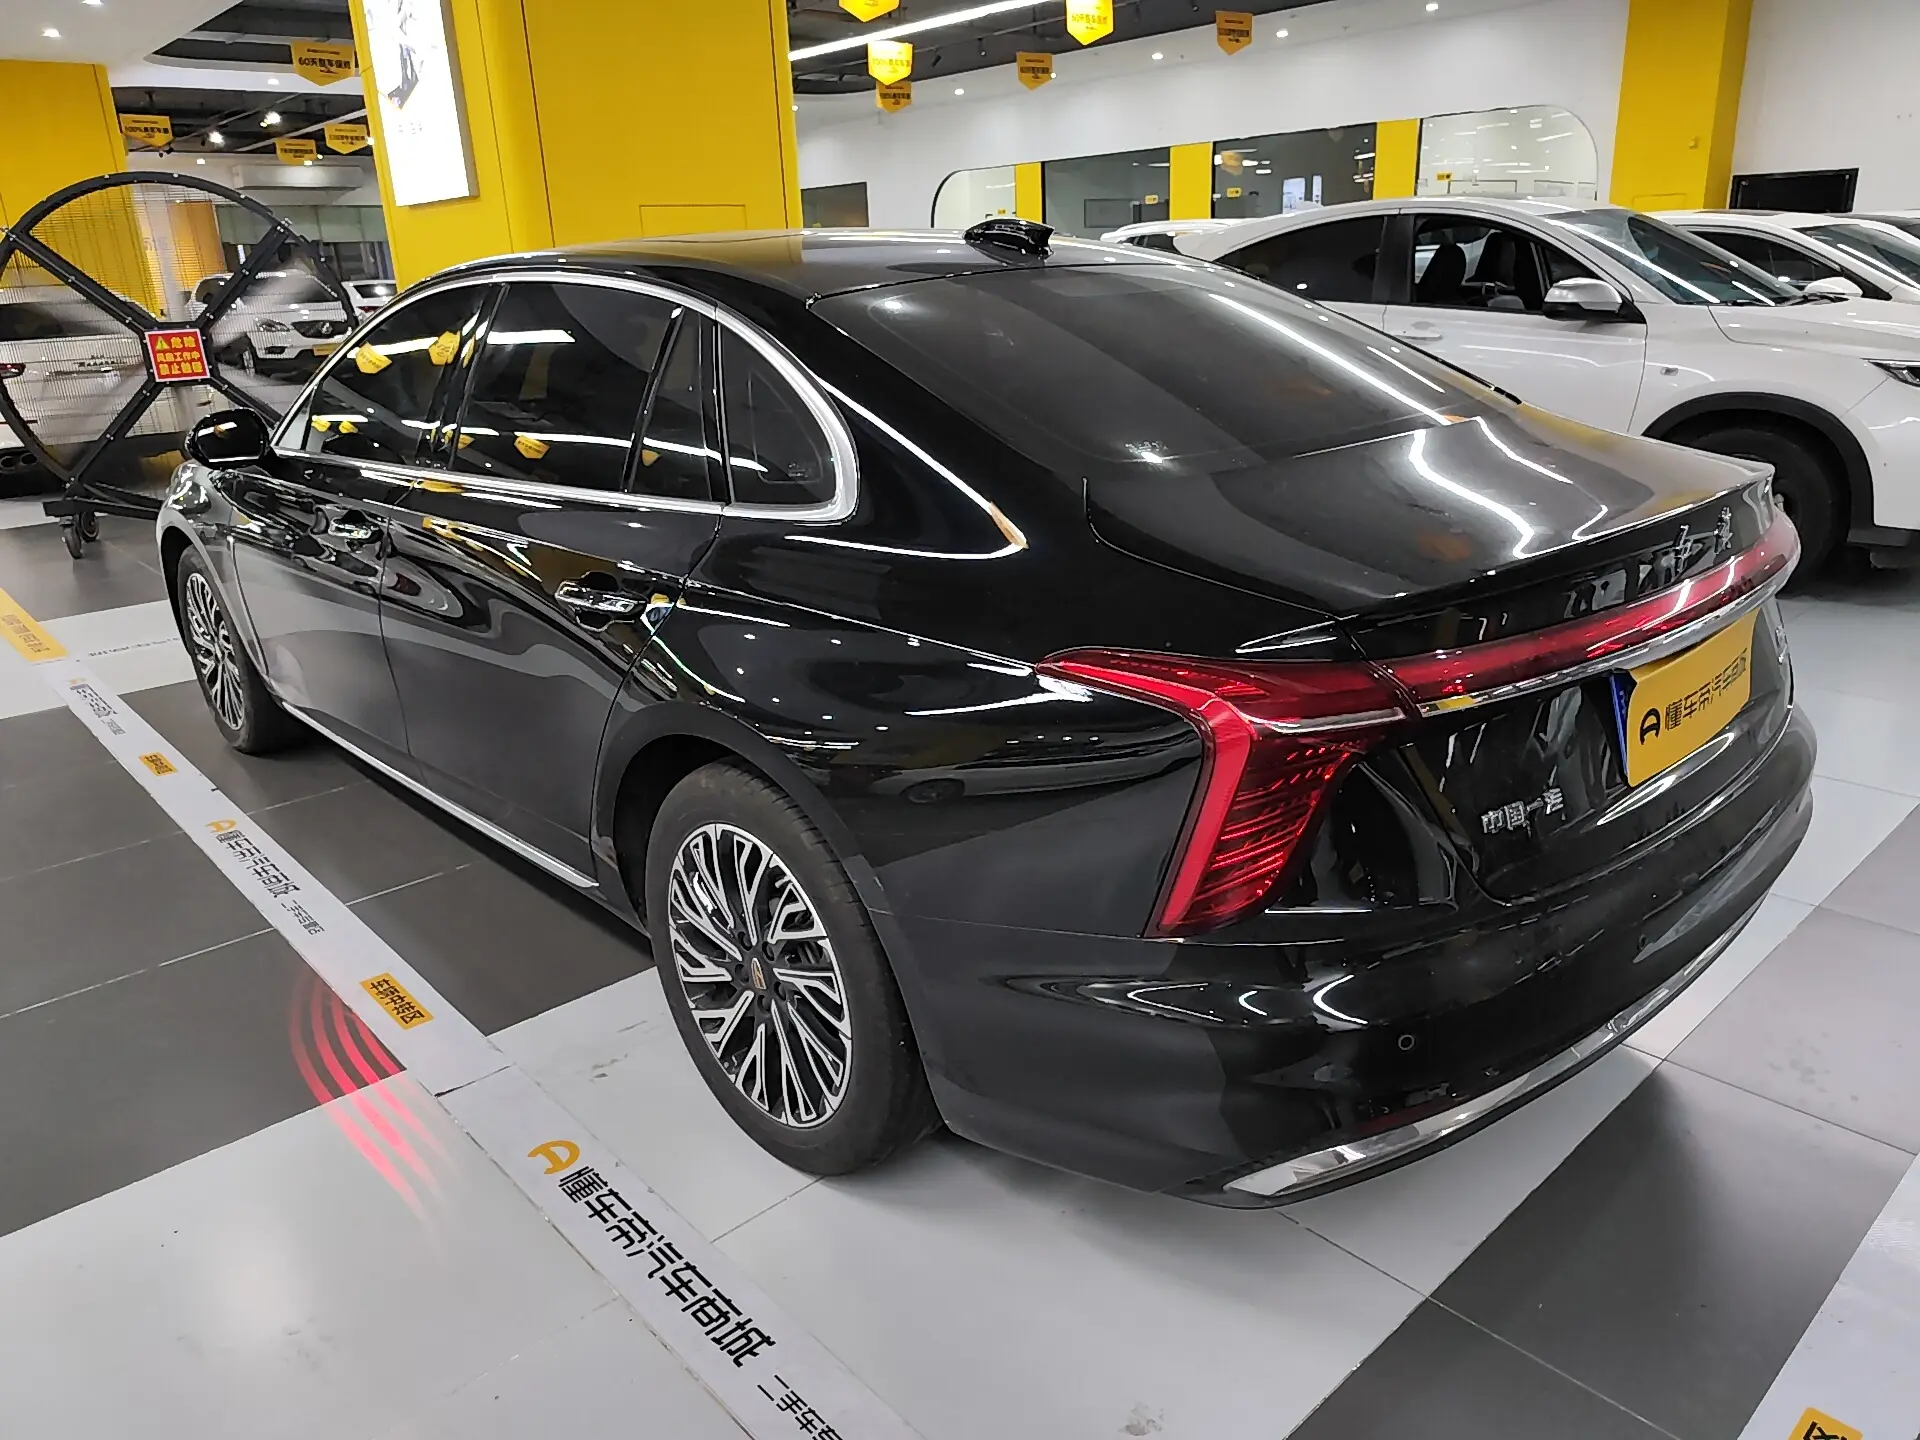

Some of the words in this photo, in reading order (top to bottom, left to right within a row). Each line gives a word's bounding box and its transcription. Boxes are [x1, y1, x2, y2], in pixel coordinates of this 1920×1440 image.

[558, 1166, 776, 1368] 懂车帝汽车商城
